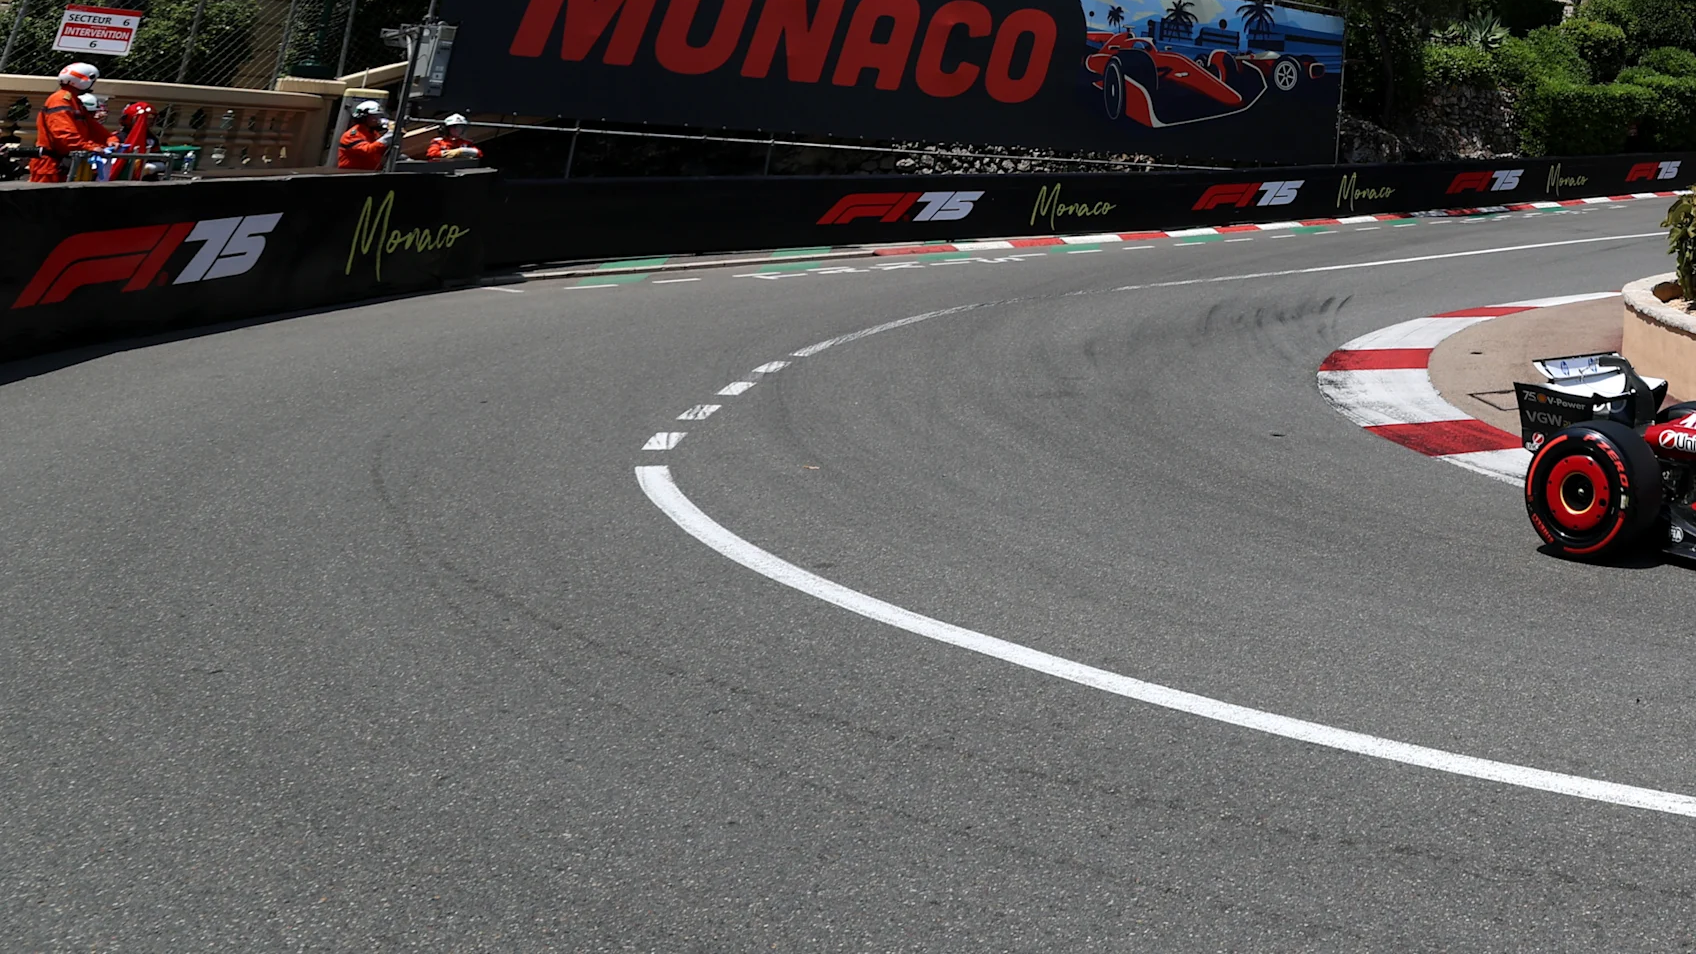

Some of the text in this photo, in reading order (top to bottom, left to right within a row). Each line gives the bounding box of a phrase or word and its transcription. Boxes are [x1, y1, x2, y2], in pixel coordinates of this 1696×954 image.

[68, 13, 131, 27] SECTEUR 6
[63, 26, 130, 40] INTERVENTION
[89, 40, 97, 49] 6
[1490, 169, 1525, 192] 75
[1546, 163, 1589, 197] Monaco
[1656, 160, 1682, 180] 75
[1256, 180, 1305, 207] 75
[1337, 172, 1395, 212] Monaco
[912, 190, 985, 222] 75
[1030, 182, 1116, 231] Monaco
[173, 212, 284, 285] 75
[345, 190, 470, 282] Monaco
[1522, 390, 1536, 402] 75
[1547, 396, 1586, 411] V-Power
[1525, 409, 1562, 427] VGW
[1595, 439, 1630, 488] ZERO
